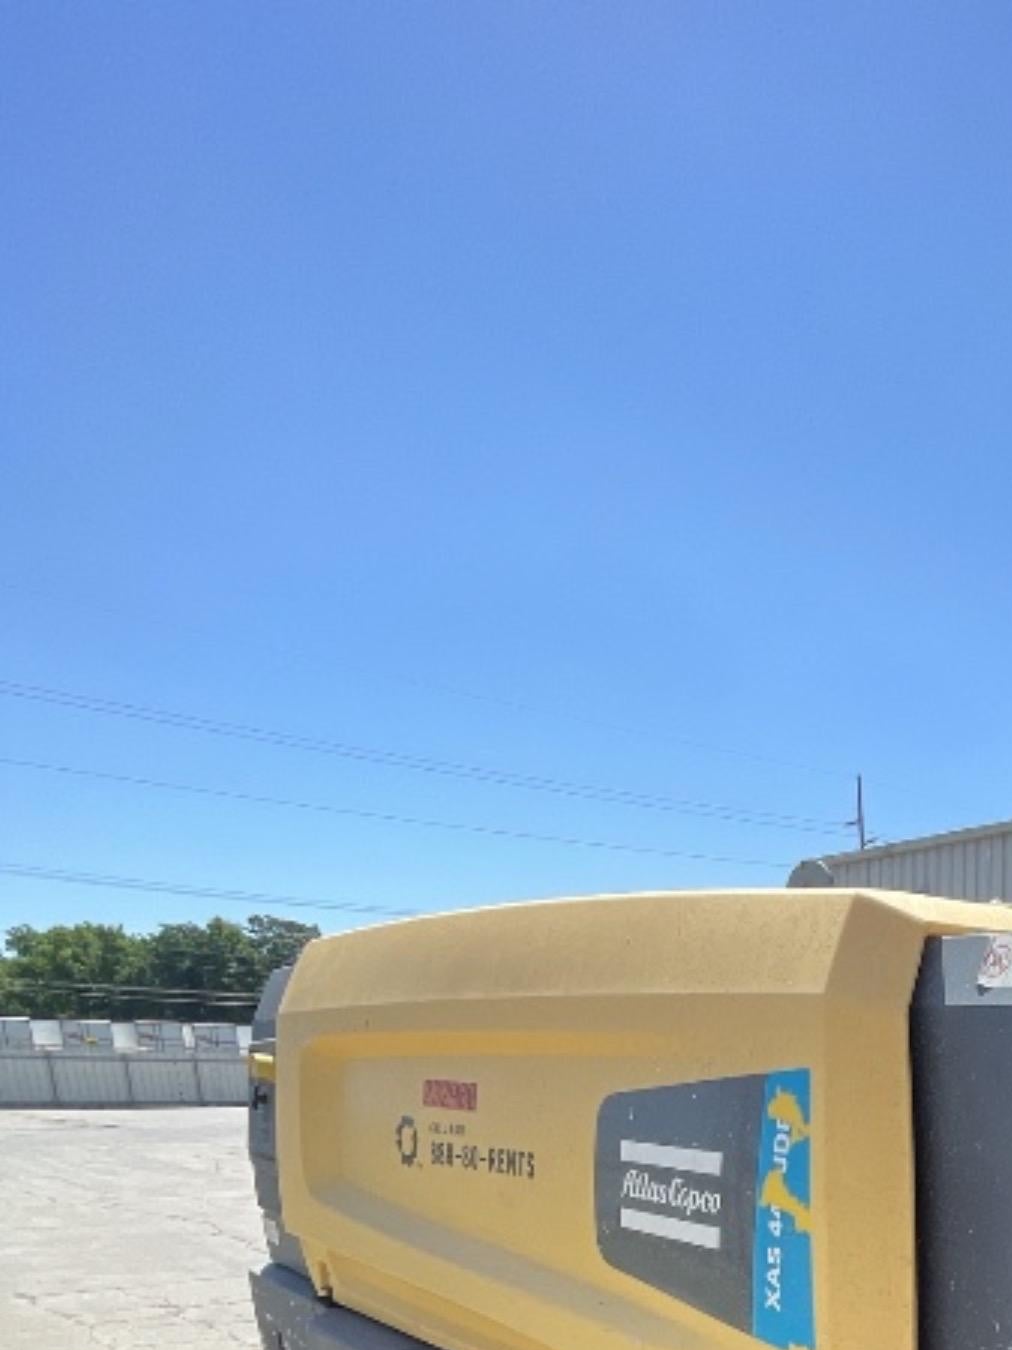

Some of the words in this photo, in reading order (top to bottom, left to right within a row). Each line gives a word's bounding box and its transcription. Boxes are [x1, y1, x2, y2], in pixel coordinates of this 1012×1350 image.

[620, 1168, 667, 1204] Atlas
[667, 1177, 721, 1216] Copco
[764, 1246, 782, 1312] XAS
